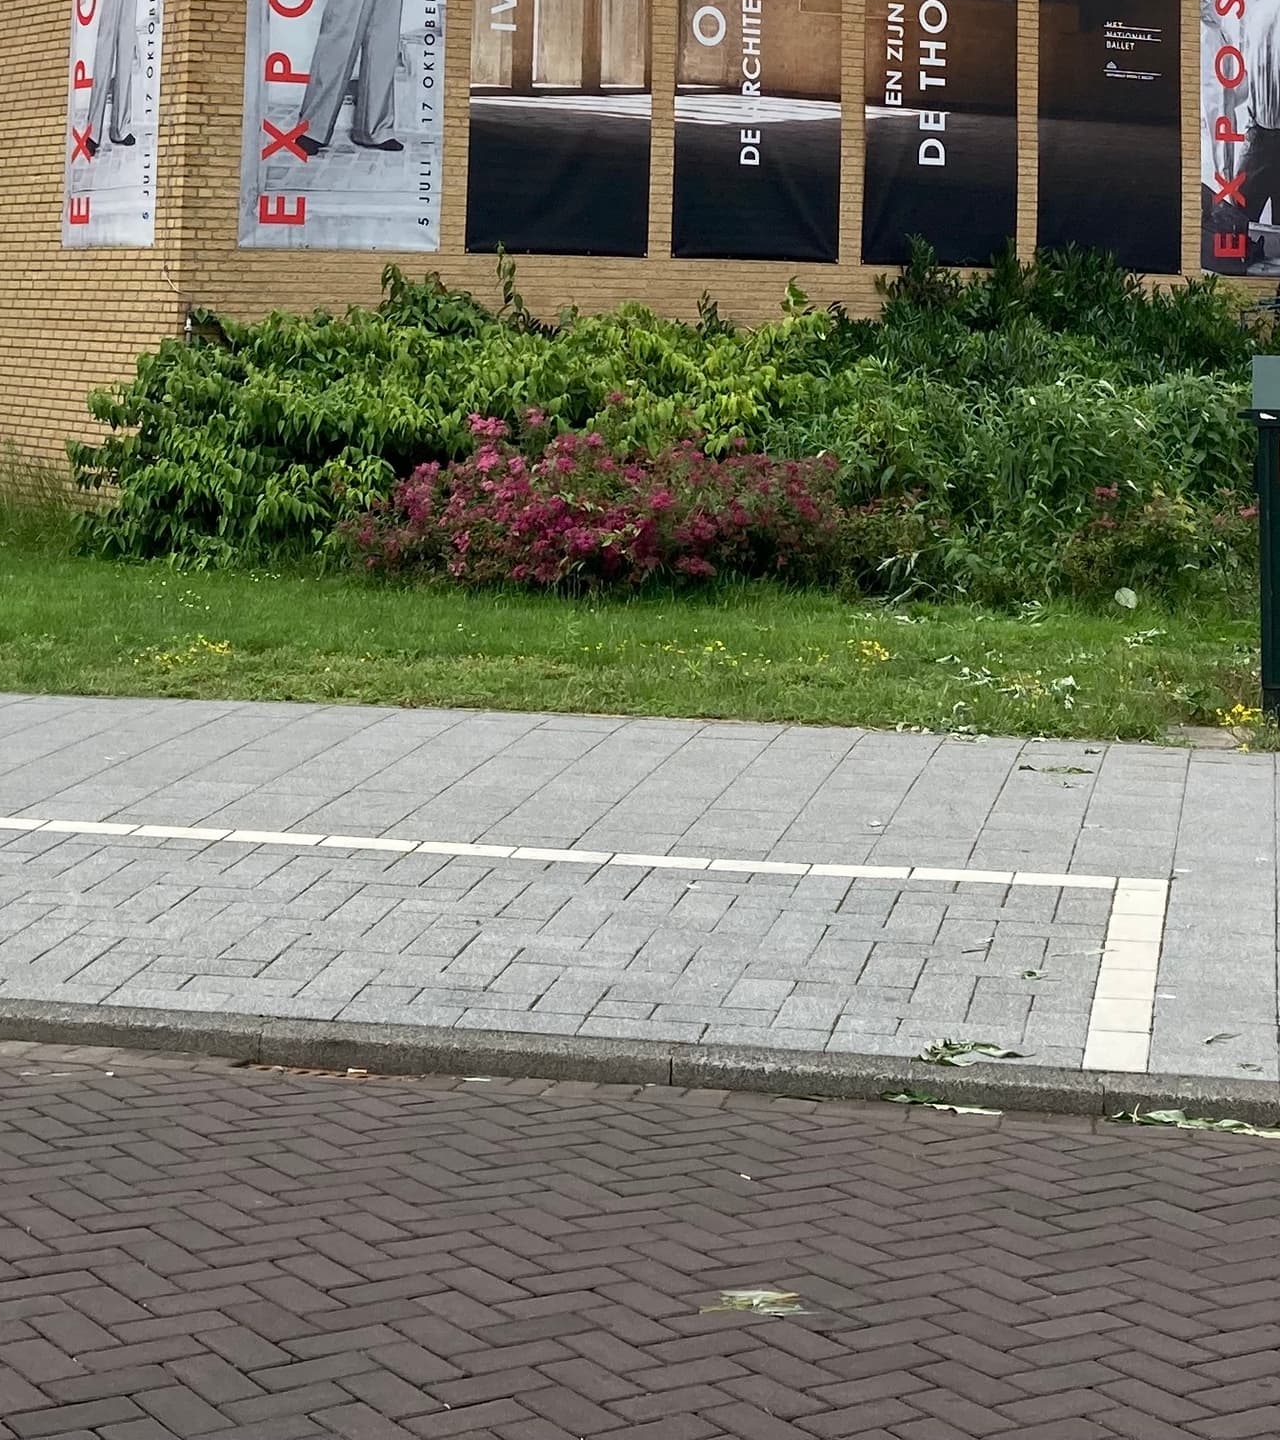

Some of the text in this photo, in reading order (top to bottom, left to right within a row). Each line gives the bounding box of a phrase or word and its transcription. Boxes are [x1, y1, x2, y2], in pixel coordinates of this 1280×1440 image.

[886, 3, 905, 65] ZIJN
[1106, 41, 1135, 50] BALLET
[145, 93, 153, 115] 17
[885, 72, 902, 106] EN
[422, 102, 433, 123] 17
[740, 129, 761, 166] DE
[919, 111, 946, 166] DE
[142, 153, 150, 196] JULI
[419, 161, 432, 203] JULI
[418, 216, 429, 226] 5
